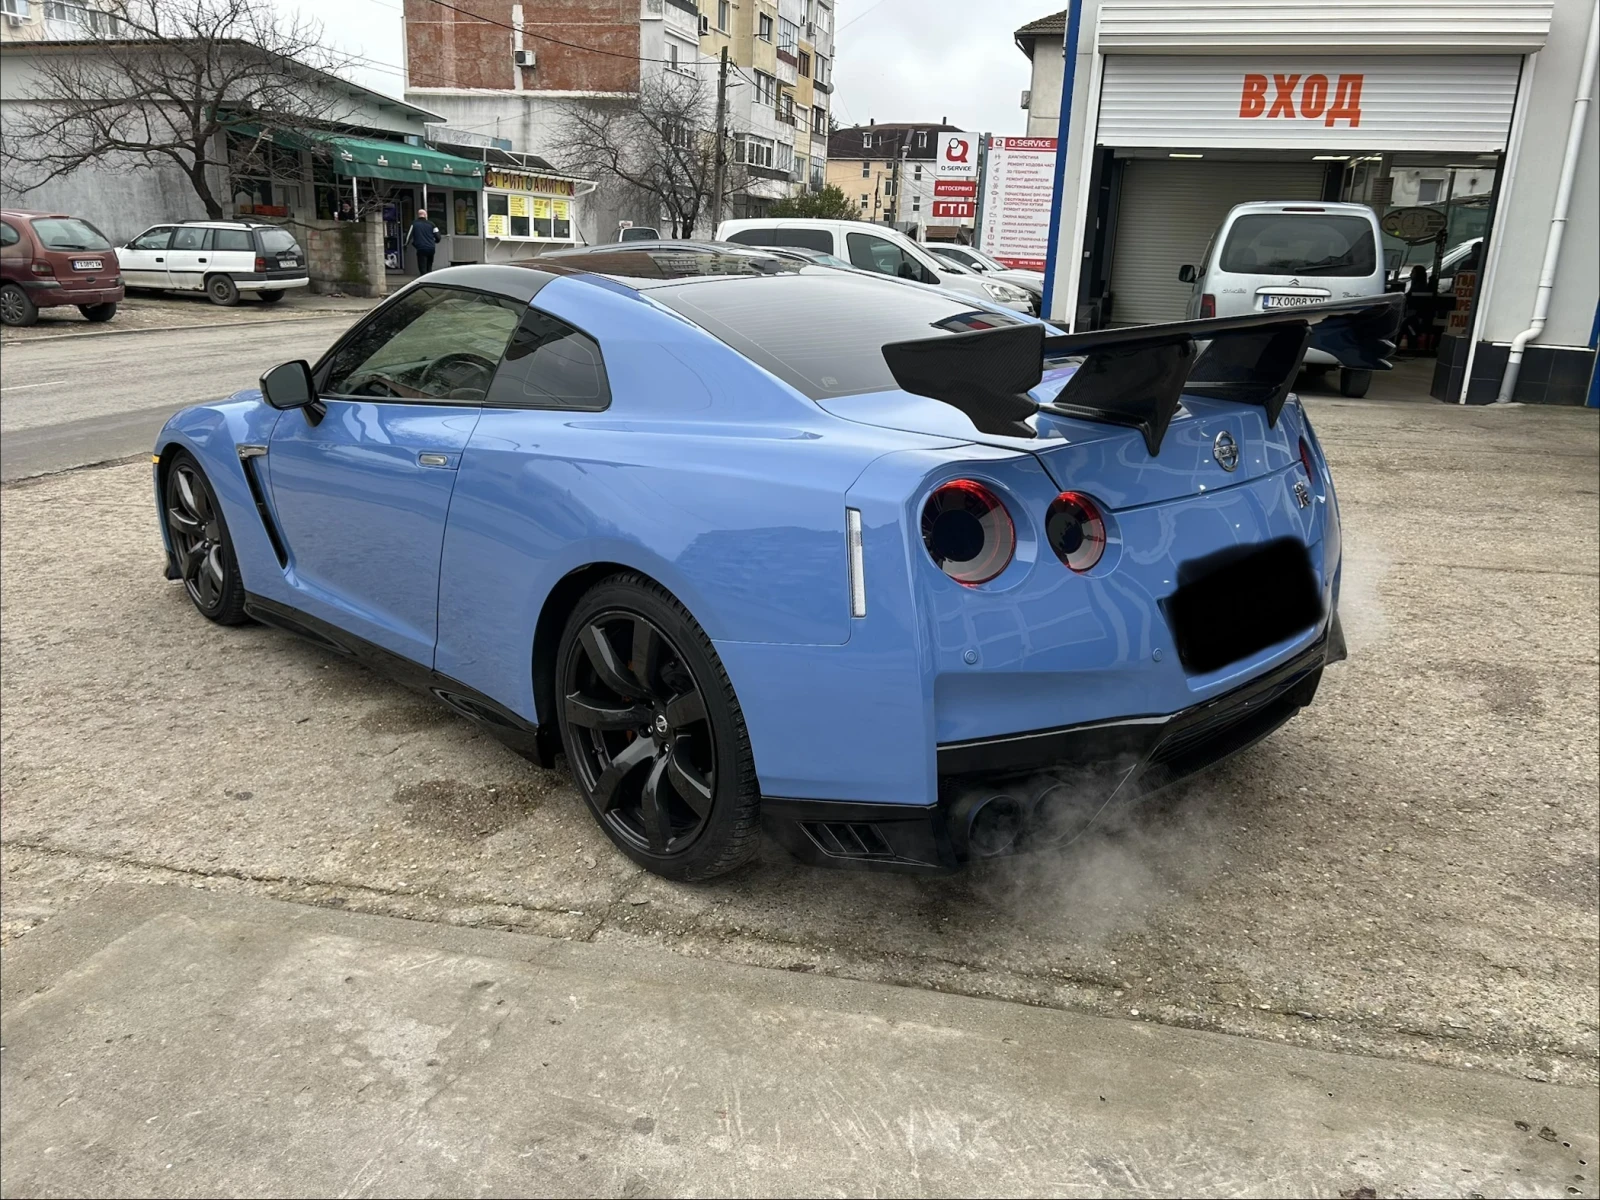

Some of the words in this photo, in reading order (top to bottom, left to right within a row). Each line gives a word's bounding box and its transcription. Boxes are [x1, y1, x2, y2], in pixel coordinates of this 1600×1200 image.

[1239, 74, 1364, 127] ВХОД
[534, 176, 566, 195] АМИГО
[939, 204, 968, 214] ГТП
[1270, 297, 1282, 306] TX
[1284, 297, 1307, 306] 0088
